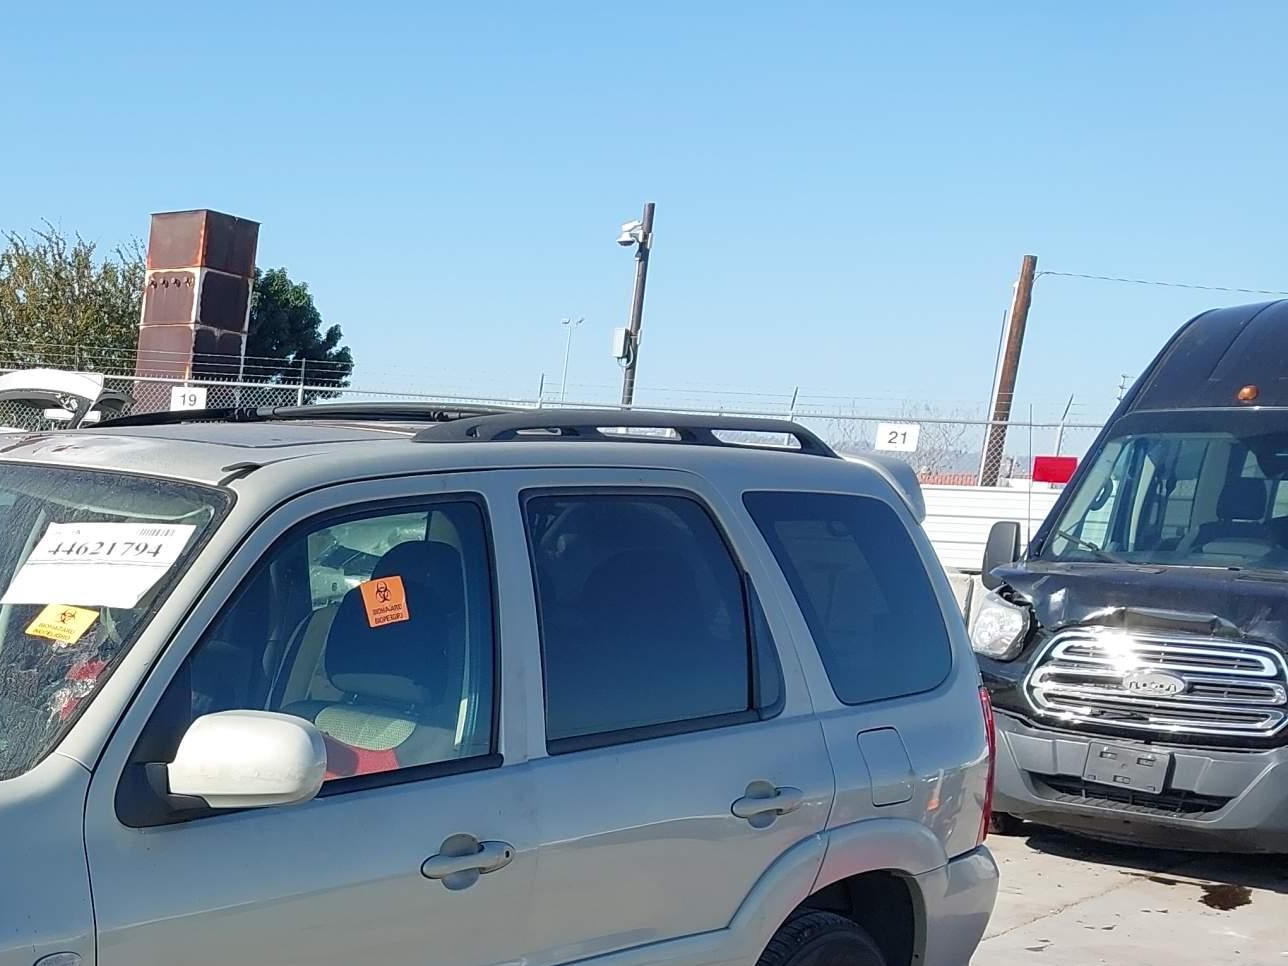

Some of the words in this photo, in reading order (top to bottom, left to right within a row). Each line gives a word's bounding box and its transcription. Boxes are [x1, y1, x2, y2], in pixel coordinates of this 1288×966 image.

[179, 393, 197, 407] 19
[887, 430, 907, 445] 21
[47, 541, 164, 558] 44621794
